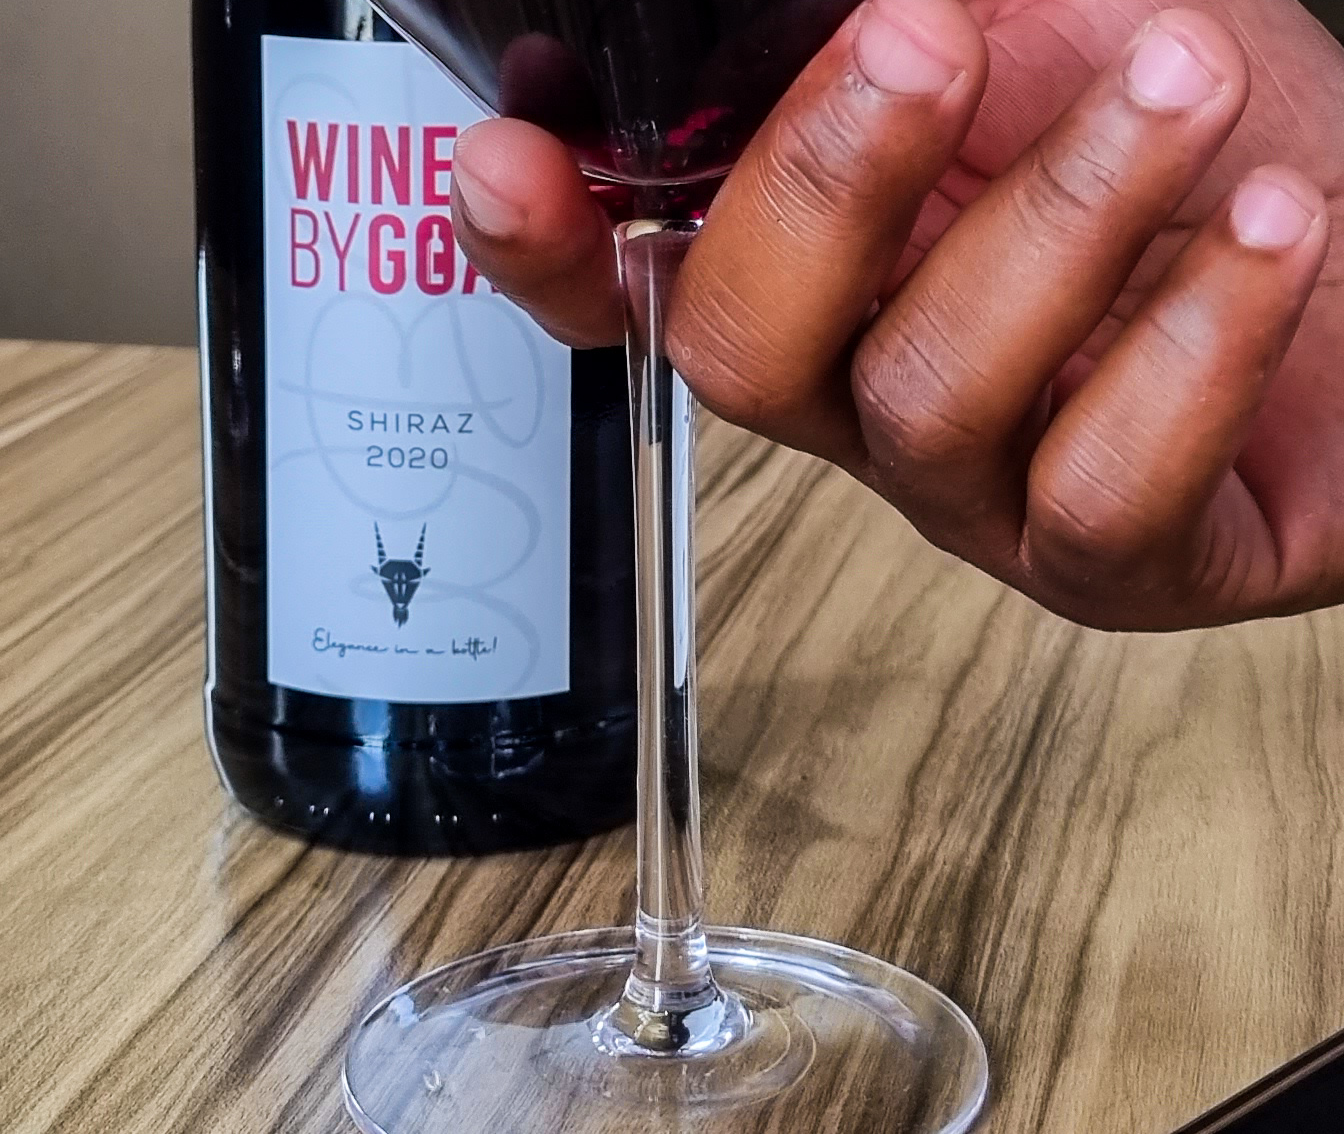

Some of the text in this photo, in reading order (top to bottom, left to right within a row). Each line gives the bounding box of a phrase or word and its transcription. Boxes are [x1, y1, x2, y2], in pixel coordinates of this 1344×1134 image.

[286, 118, 457, 207] WINE
[346, 410, 475, 435] SHIRAZ
[366, 444, 449, 470] 2020
[312, 627, 390, 658] Elegance
